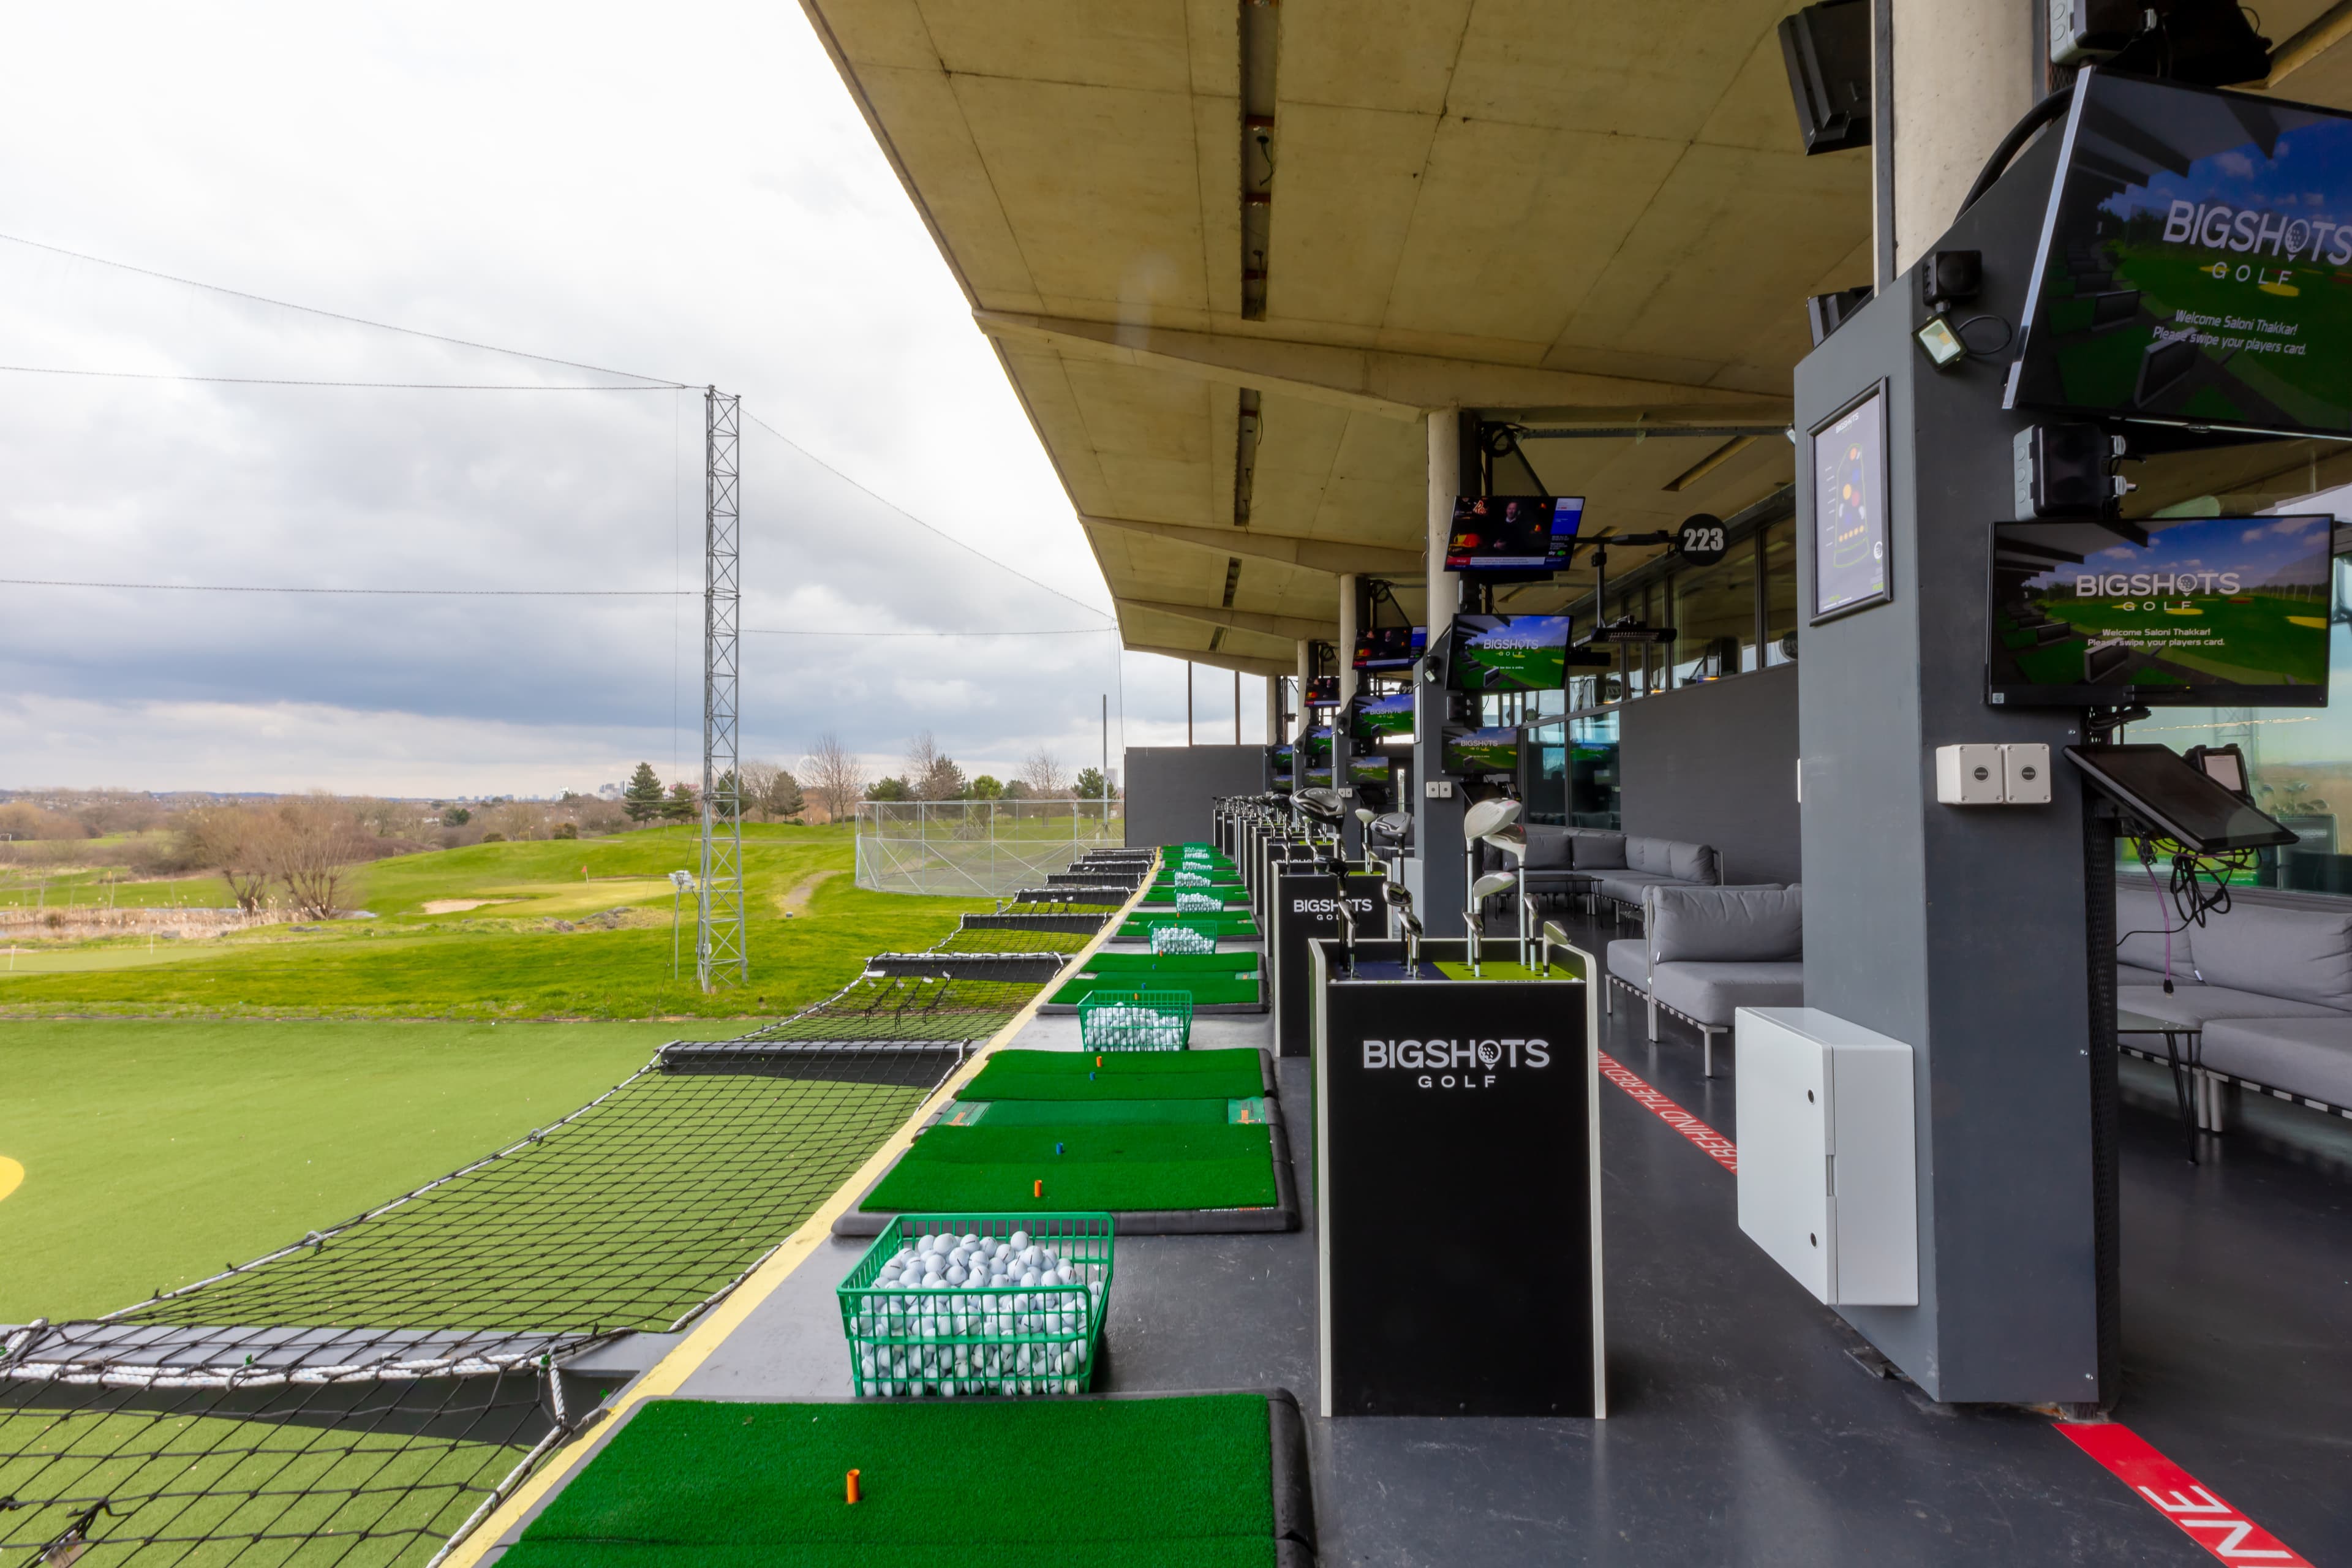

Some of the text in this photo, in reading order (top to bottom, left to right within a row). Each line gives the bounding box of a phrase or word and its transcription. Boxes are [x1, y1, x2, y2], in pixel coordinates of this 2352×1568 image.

[2162, 200, 2352, 265] BIGSHOTS
[2212, 262, 2292, 286] GOLF
[2175, 309, 2298, 336] Welcome Saloni Thakkar!
[2153, 326, 2307, 355] Please swipe your players card.
[1684, 528, 1724, 551] 223
[2076, 573, 2241, 597] BIGSHOTS
[2123, 601, 2192, 611] GOLF
[1483, 639, 1539, 650] BIGSHOTS
[2119, 639, 2144, 647] swipe
[2169, 638, 2201, 647] players
[1294, 899, 1372, 913] BIGSHTS
[1363, 1039, 1550, 1070] BIGSHOTS
[1418, 1075, 1496, 1088] GOLF
[1598, 1051, 1738, 1157] BEHIND THE RED LIN
